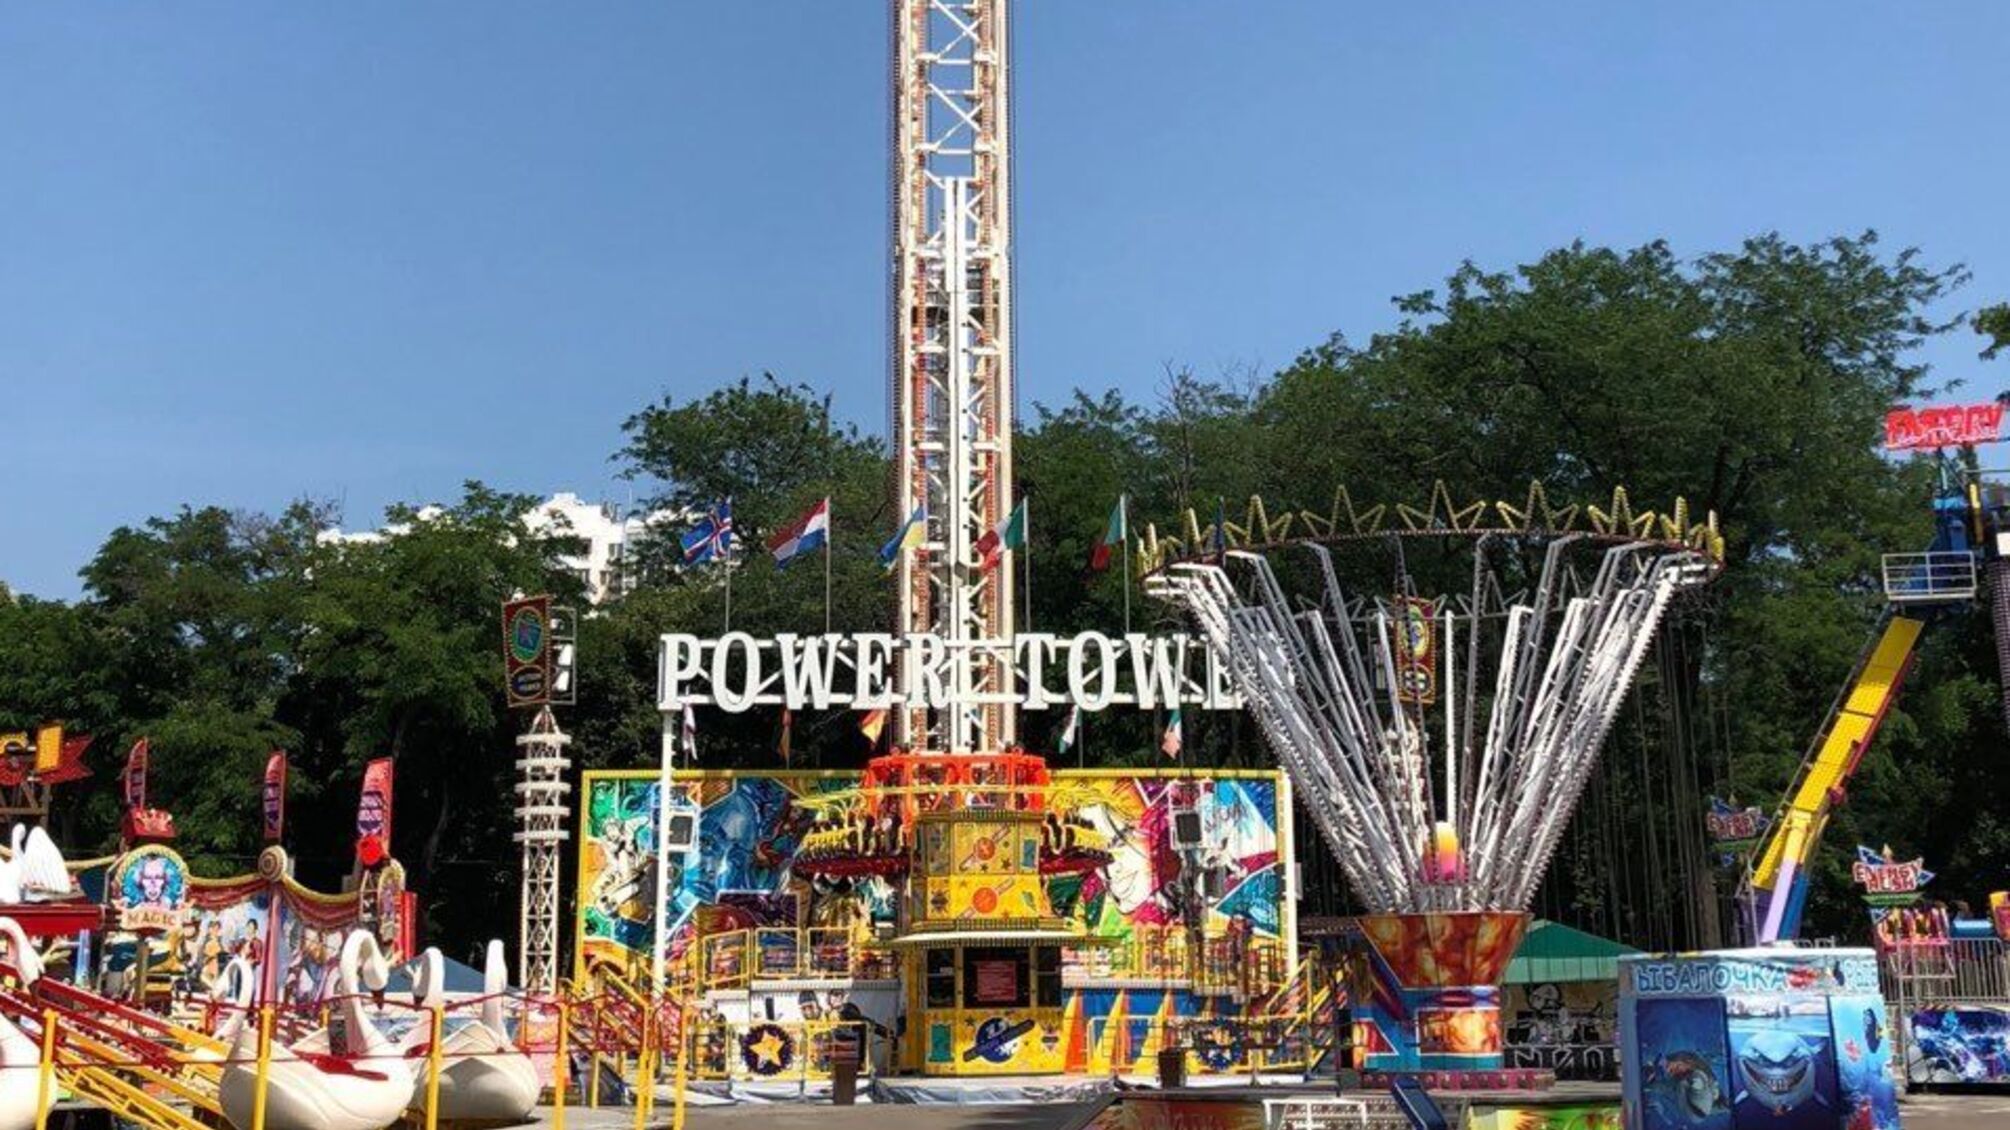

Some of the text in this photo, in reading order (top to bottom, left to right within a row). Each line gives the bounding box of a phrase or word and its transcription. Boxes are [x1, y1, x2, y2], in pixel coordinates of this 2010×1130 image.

[658, 630, 1243, 712] POWER TOWE
[127, 911, 176, 926] MAGIC
